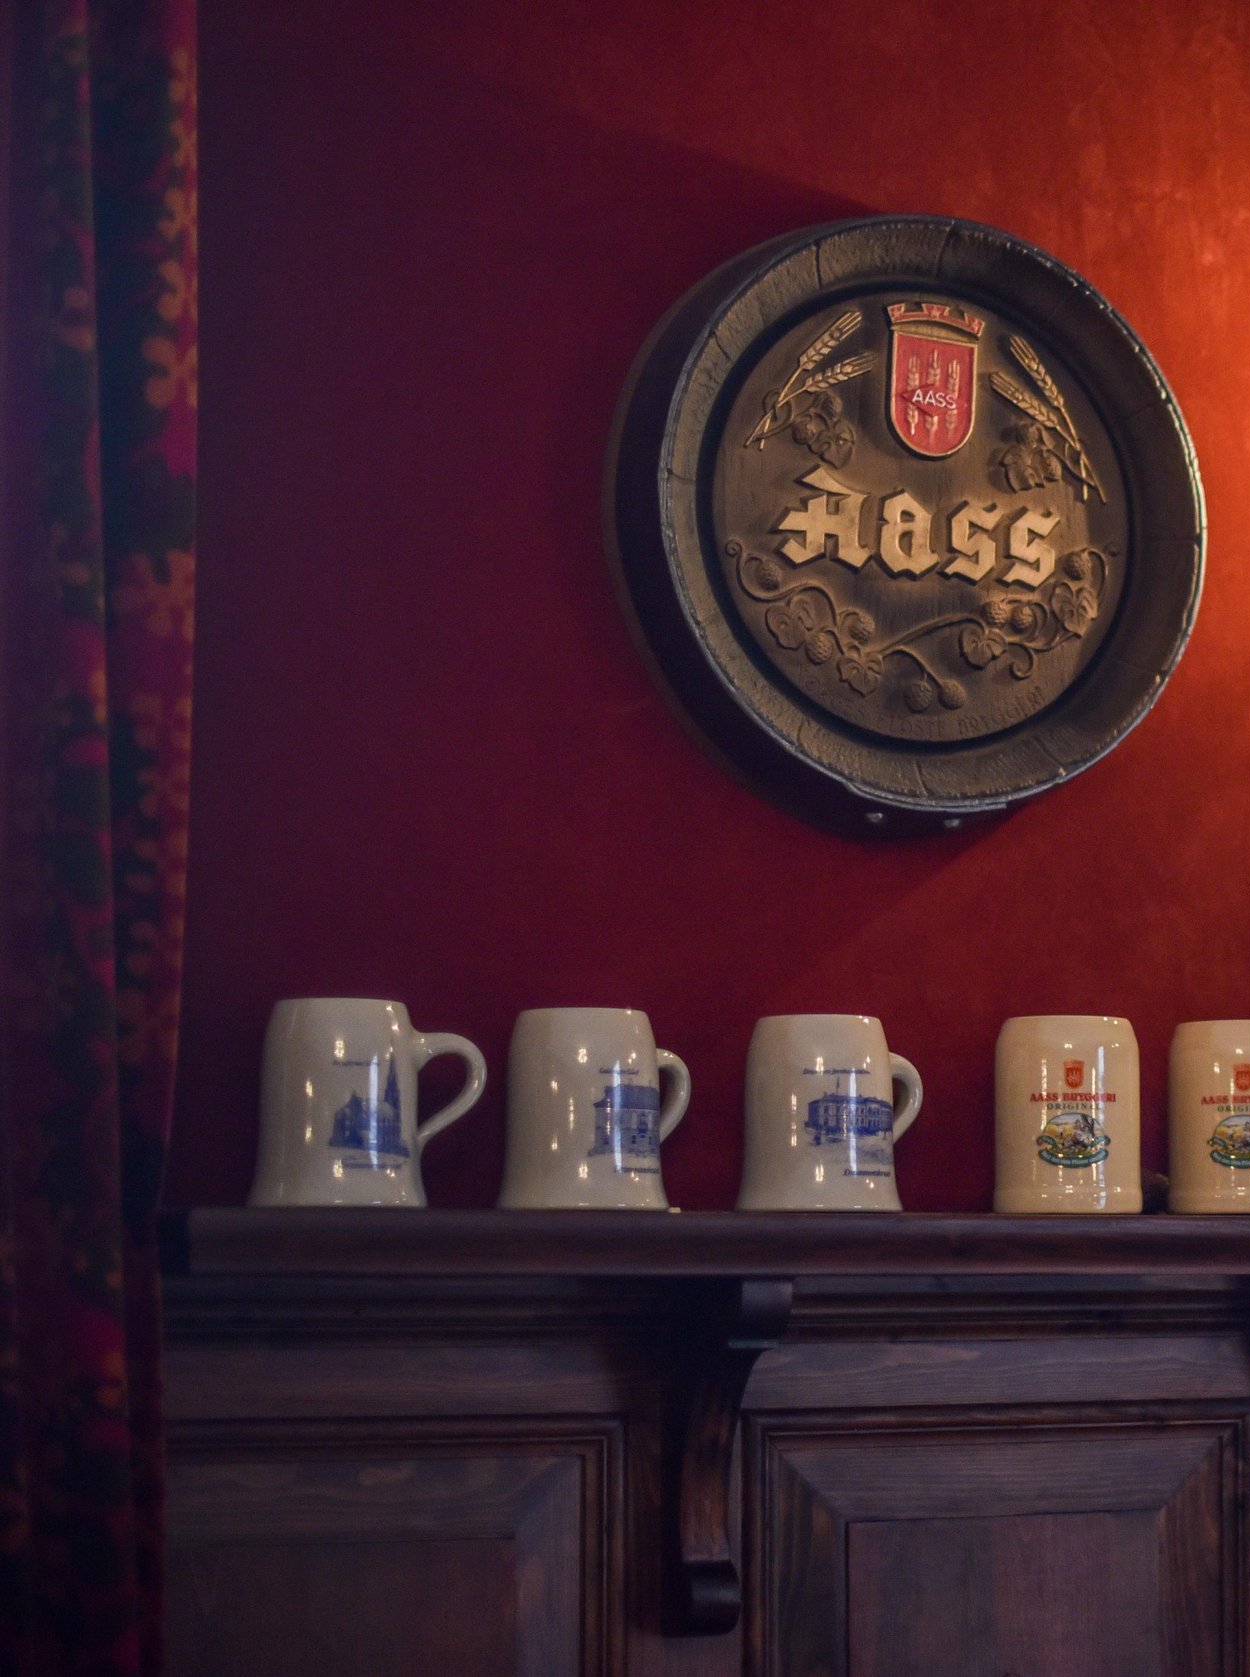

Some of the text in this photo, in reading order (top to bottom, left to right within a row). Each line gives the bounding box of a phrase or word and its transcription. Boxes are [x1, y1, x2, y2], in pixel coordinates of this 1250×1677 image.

[912, 388, 957, 410] AASS
[772, 465, 1061, 588] Aass
[1029, 1092, 1059, 1103] AASS
